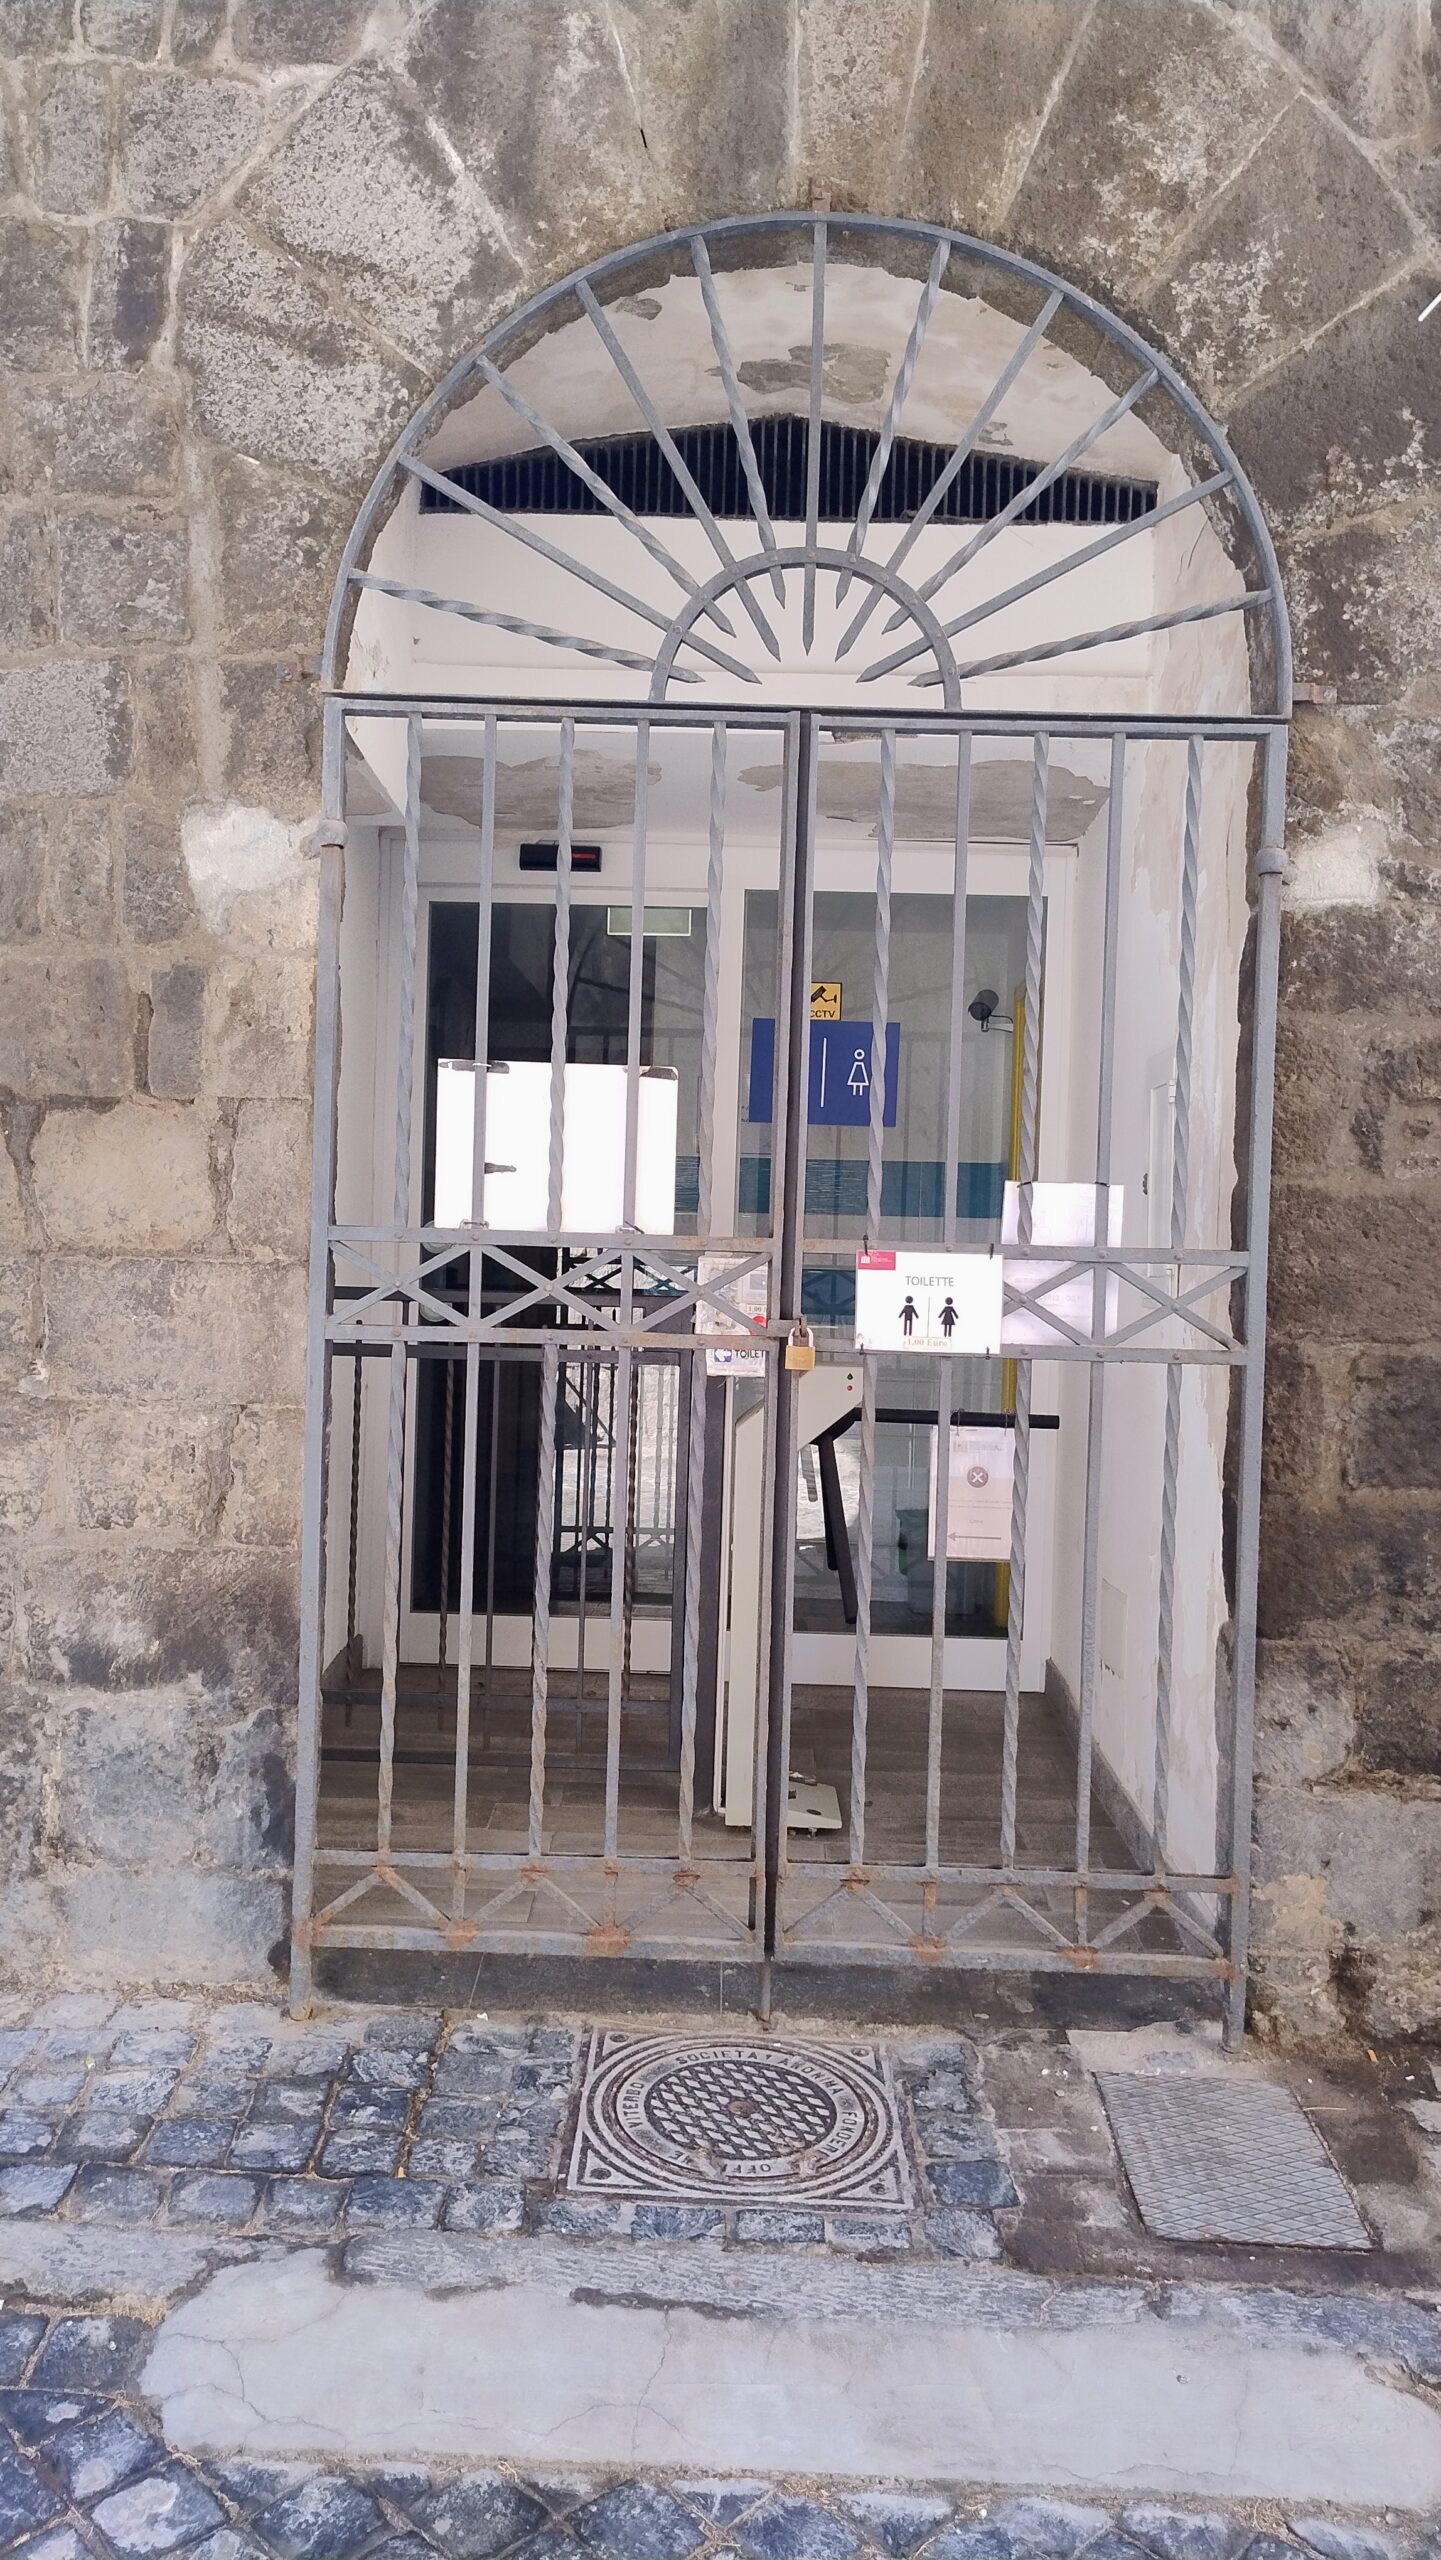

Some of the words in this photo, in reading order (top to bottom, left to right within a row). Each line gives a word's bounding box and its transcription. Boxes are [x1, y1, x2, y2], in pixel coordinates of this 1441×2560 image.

[905, 1276, 954, 1287] TOILETTE
[927, 1338, 948, 1347] Euro
[623, 2082, 645, 2128] VITERBO
